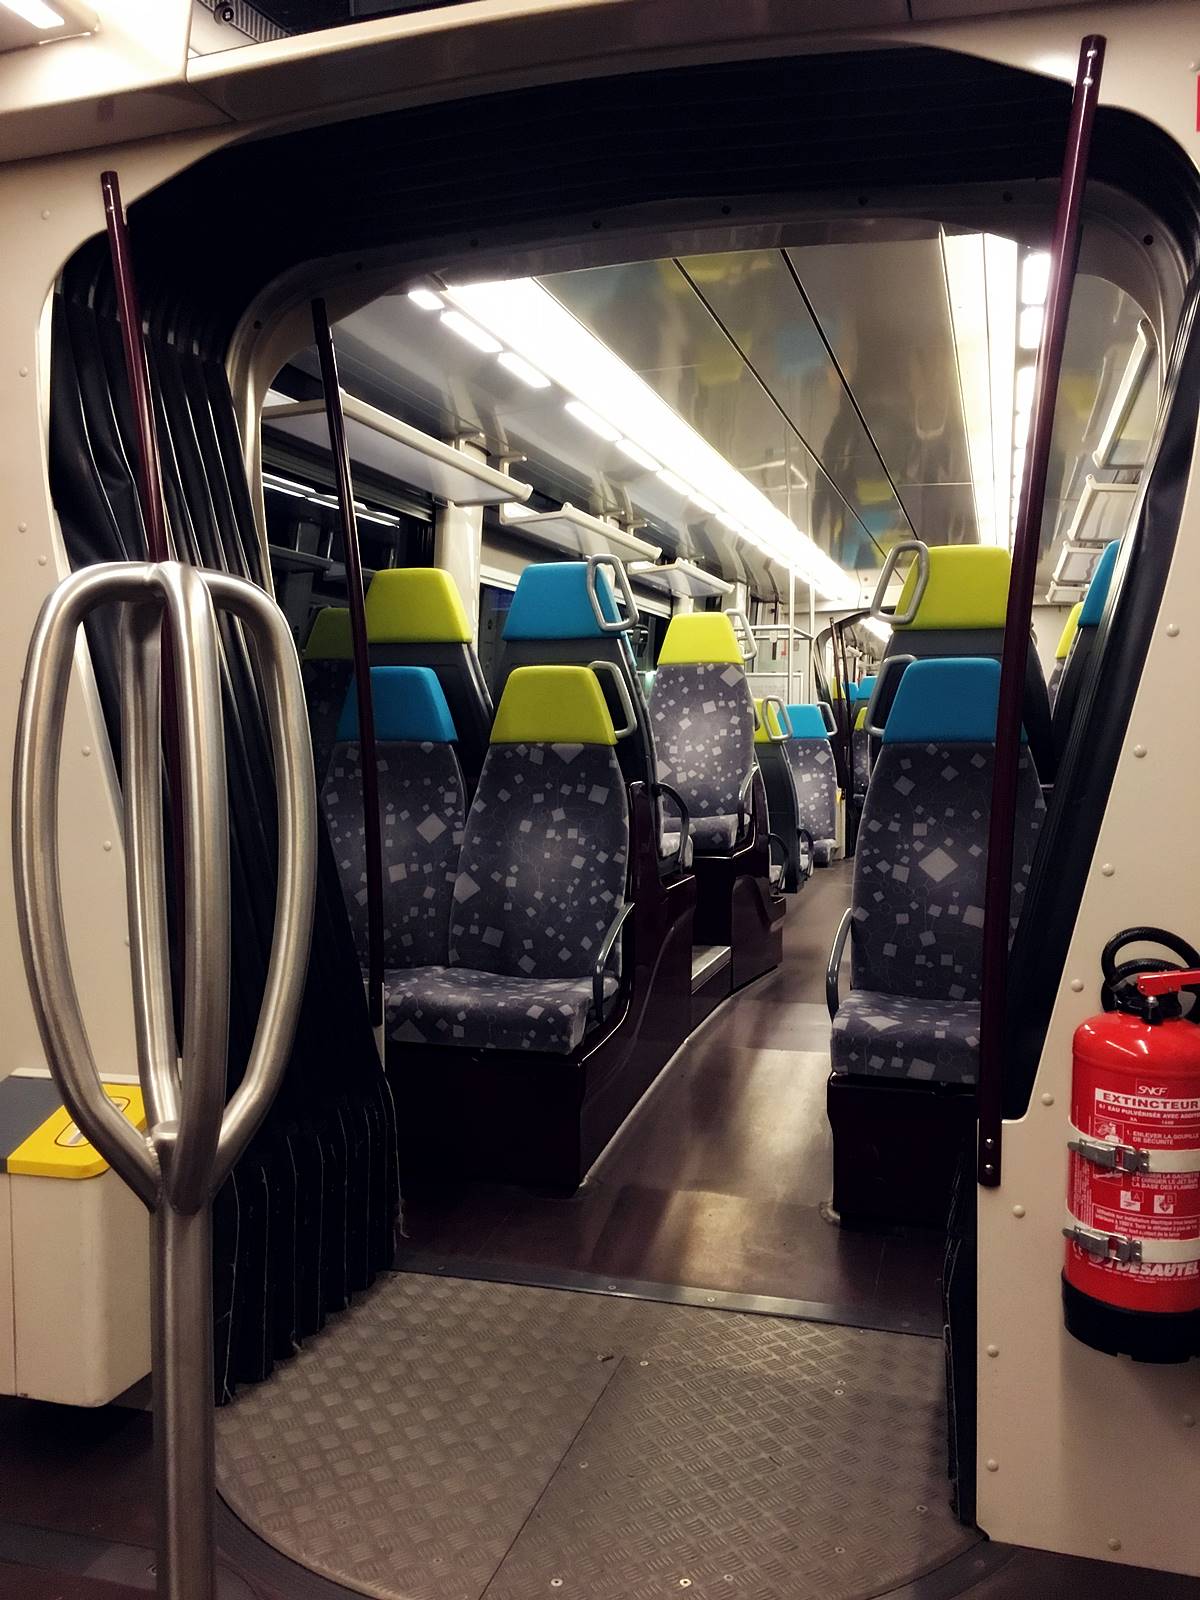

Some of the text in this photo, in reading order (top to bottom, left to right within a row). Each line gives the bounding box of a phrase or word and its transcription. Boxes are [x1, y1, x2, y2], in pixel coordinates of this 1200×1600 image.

[1138, 1085, 1168, 1096] SNCF
[1103, 1092, 1199, 1110] EXTINCTEUR
[1107, 1105, 1120, 1113] EAU
[1132, 1130, 1162, 1139] ENLEVER
[1133, 1193, 1141, 1201] A
[1116, 1260, 1199, 1278] DESAUTEL
